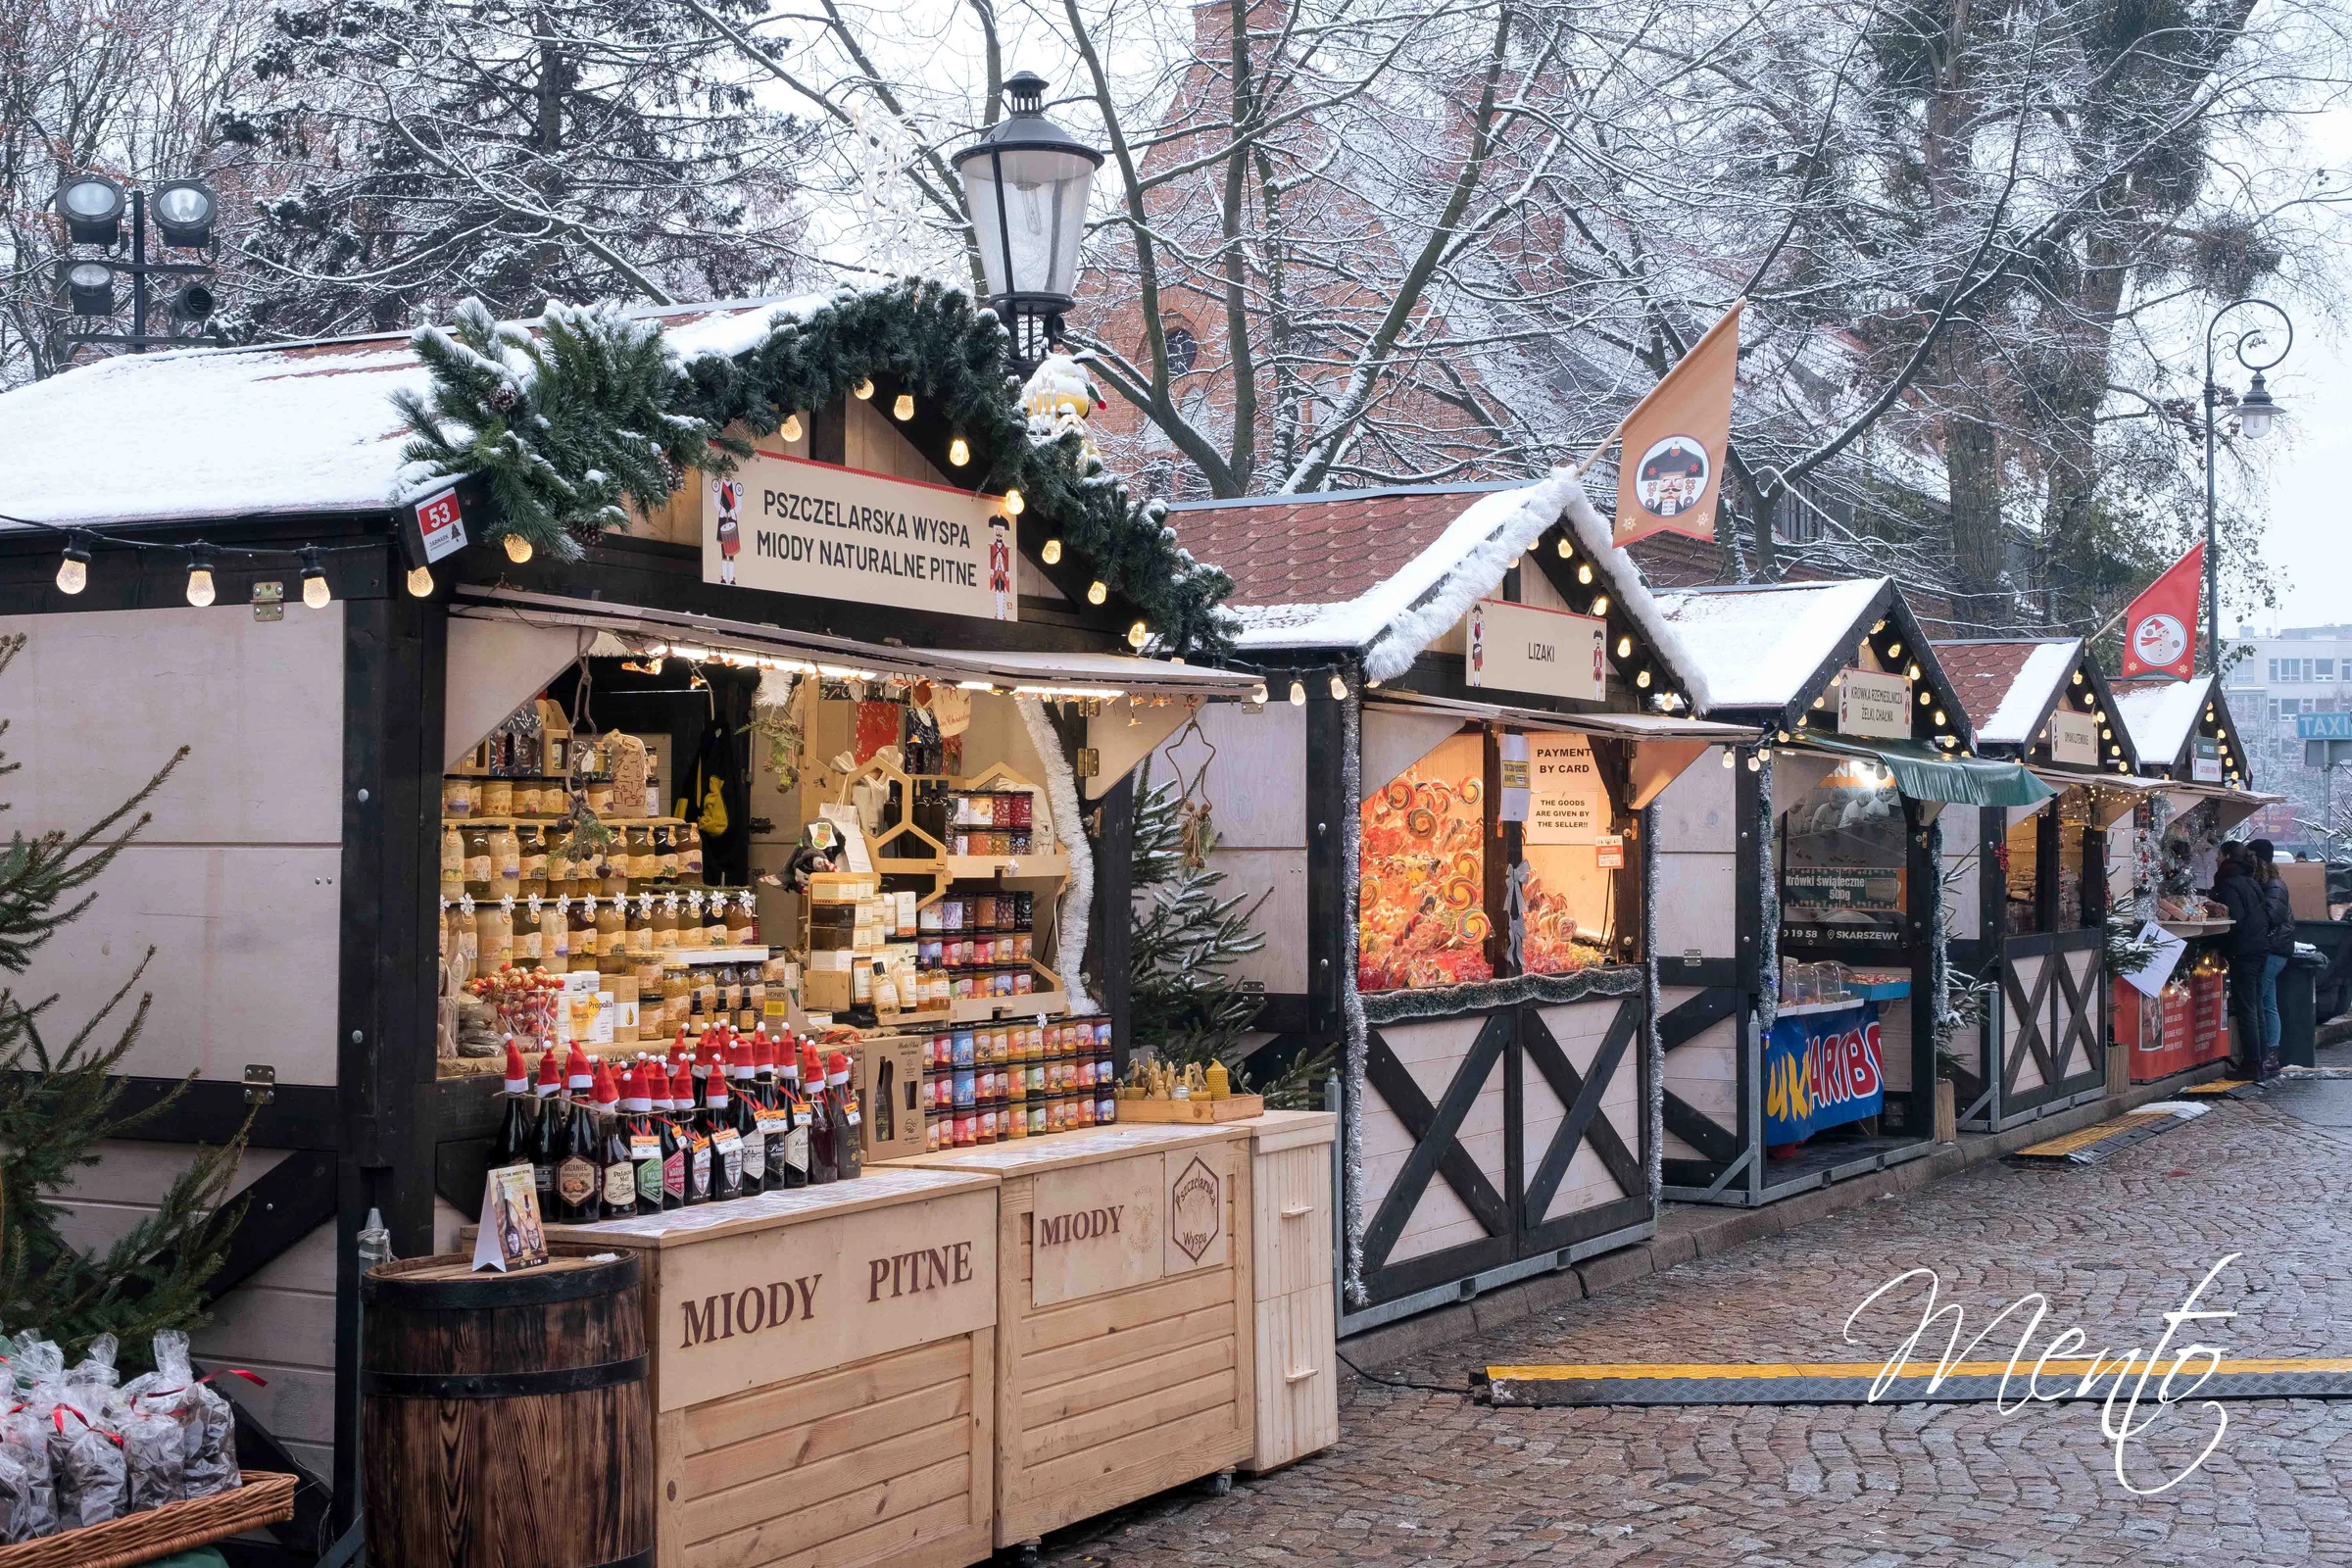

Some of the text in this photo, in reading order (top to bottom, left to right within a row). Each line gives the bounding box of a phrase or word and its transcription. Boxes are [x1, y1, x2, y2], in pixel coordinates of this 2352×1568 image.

[428, 502, 451, 528] 53
[763, 489, 970, 549] PSZCZELARSKA WYSPA
[757, 529, 977, 587] MIODY NATURALNE PITNE
[1528, 642, 1555, 662] LIZAKI
[1851, 684, 1872, 700] KRÓWKA
[2299, 716, 2349, 736] TAXI
[1537, 748, 1592, 758] PAYMENT
[1540, 764, 1590, 774] BY CARD
[1786, 875, 1865, 890] Krówki świąteczne
[1829, 889, 1851, 901] 500g
[1791, 929, 1803, 938] 19
[1836, 931, 1899, 941] SKARSZEWY
[588, 1001, 613, 1010] Propolis
[1765, 1021, 1884, 1123] UK ARIB
[1175, 1167, 1216, 1211] Pszczelarska
[1040, 1205, 1125, 1248] MIODY
[1183, 1231, 1207, 1251] Wyspa
[680, 1241, 973, 1348] MIODY PITNE
